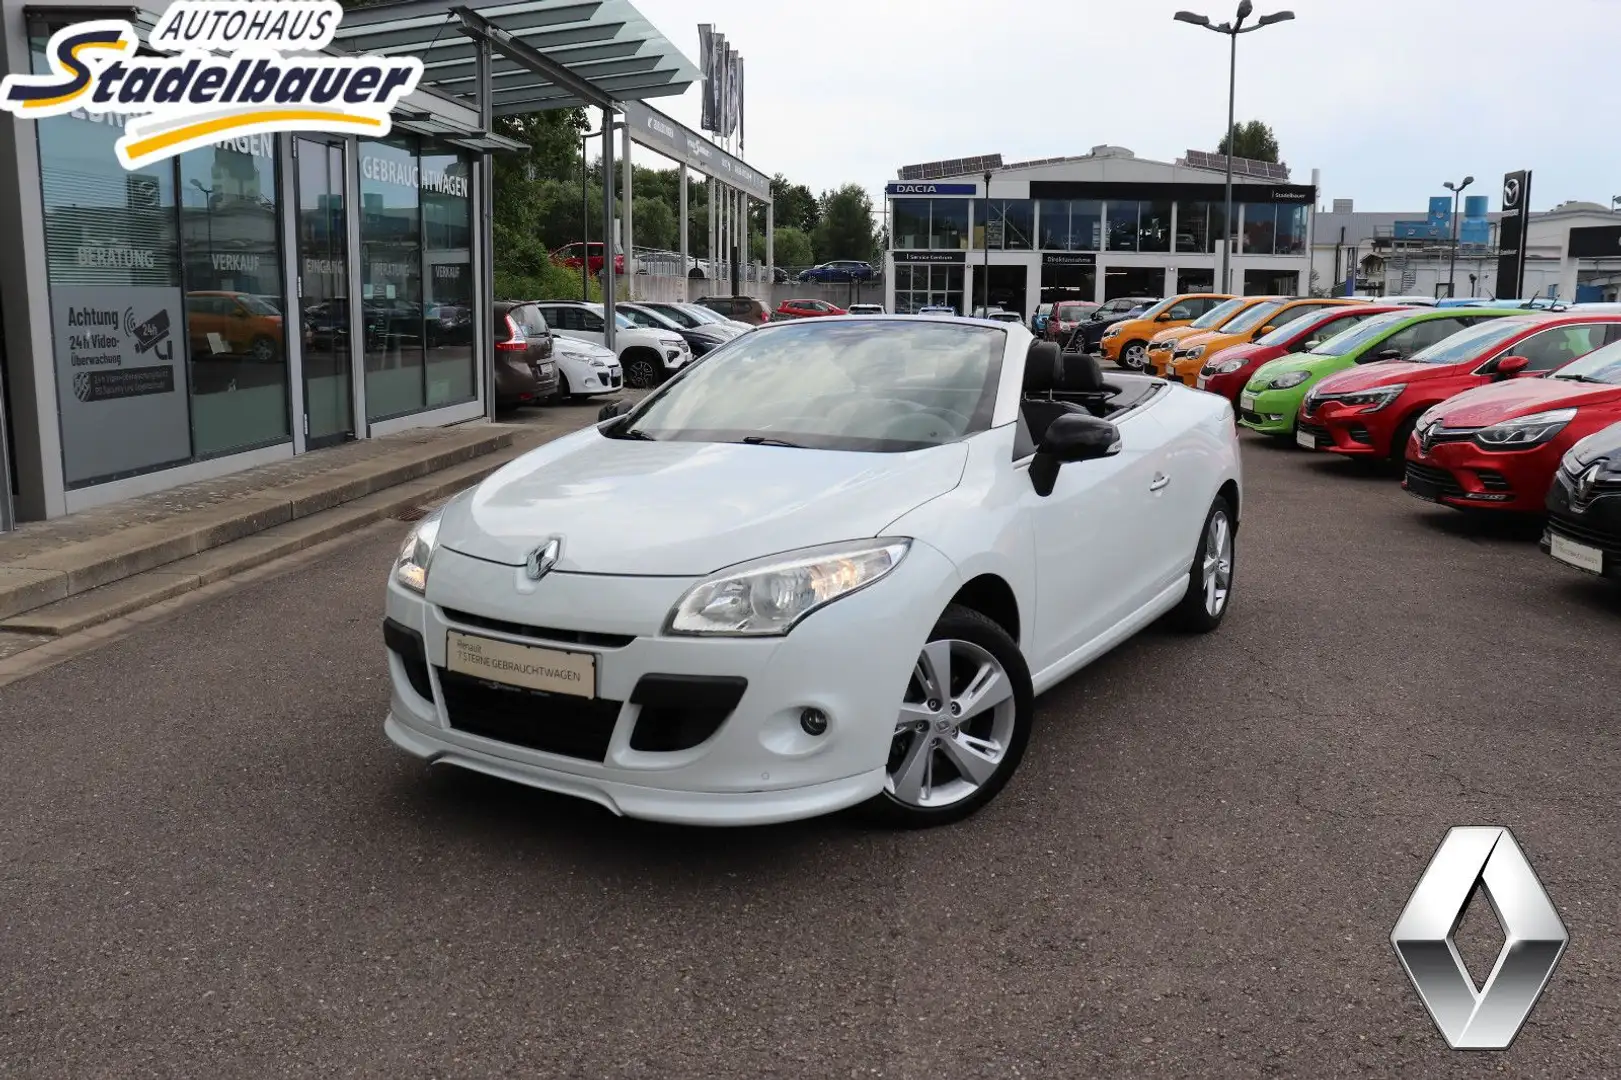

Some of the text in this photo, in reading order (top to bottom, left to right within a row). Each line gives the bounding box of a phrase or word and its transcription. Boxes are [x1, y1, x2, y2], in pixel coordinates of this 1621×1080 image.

[362, 155, 468, 198] GEBRAUCHTWAGEN
[896, 184, 937, 193] DACIA
[78, 247, 154, 268] BERATUNG
[212, 253, 260, 272] VERKAUF
[68, 307, 119, 331] Achtung
[142, 323, 158, 337] 24h
[91, 334, 120, 349] Video-
[71, 351, 121, 367] Überwachung
[463, 652, 491, 667] STERNE
[492, 657, 581, 682] GEBRAUCHTWAGEN
